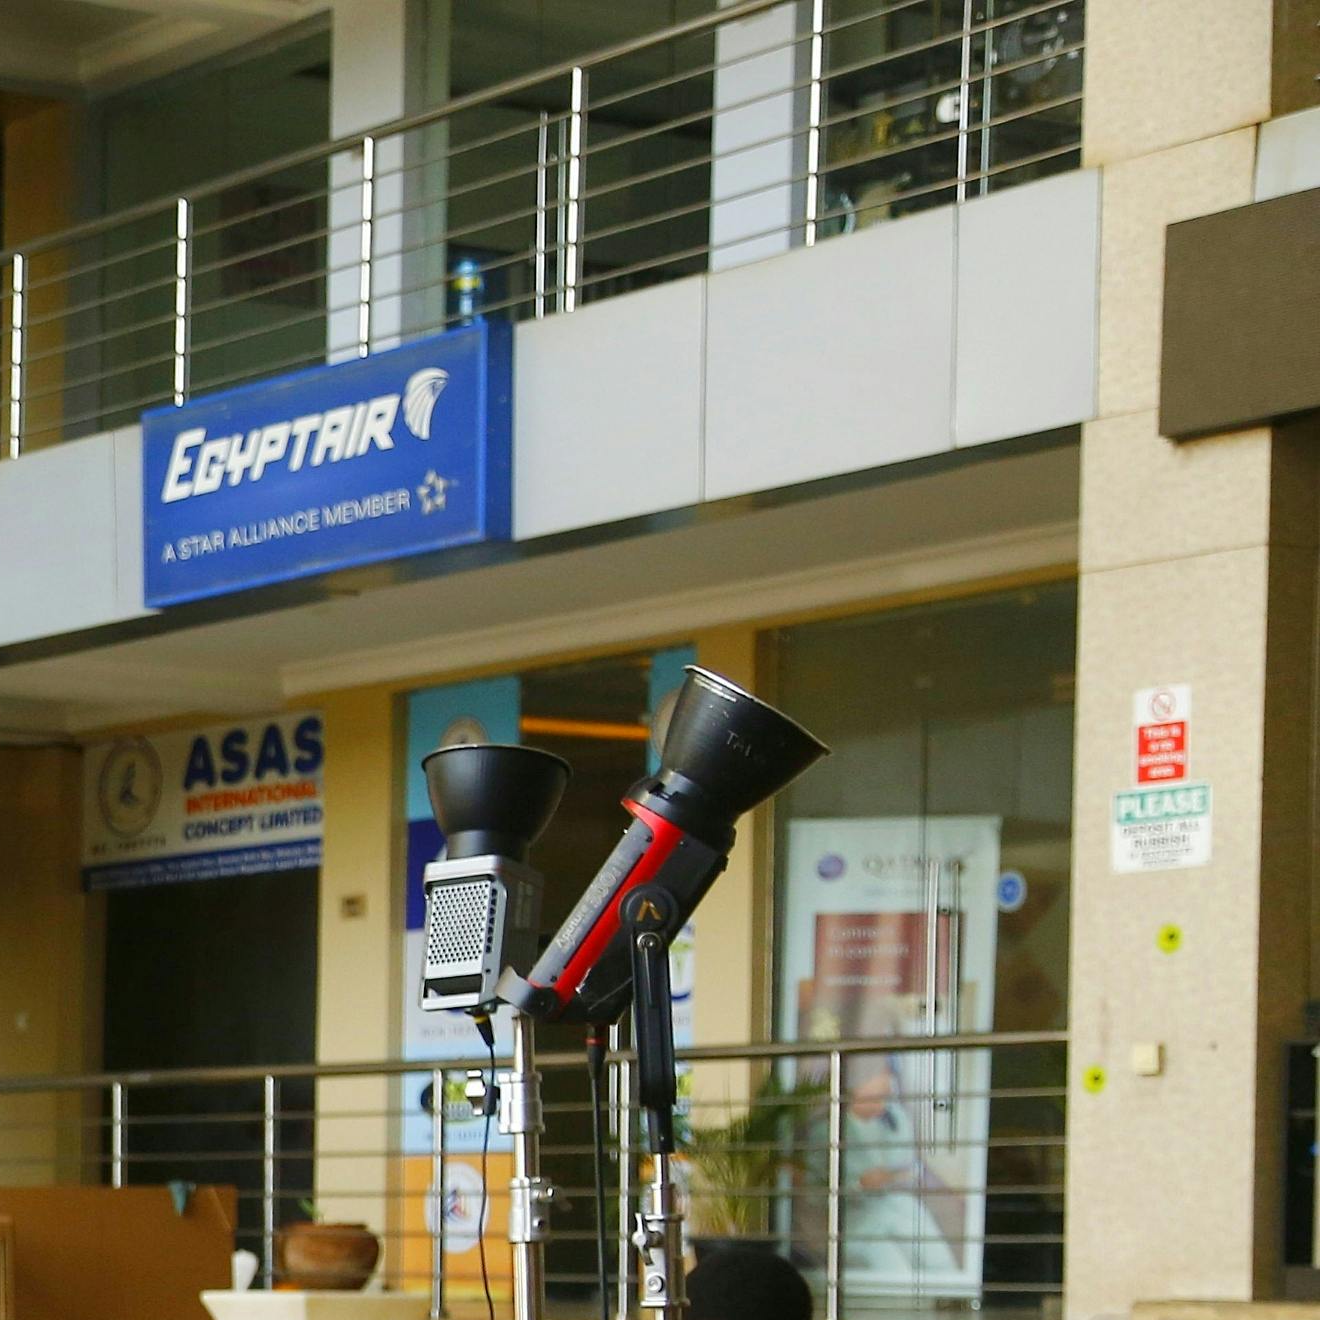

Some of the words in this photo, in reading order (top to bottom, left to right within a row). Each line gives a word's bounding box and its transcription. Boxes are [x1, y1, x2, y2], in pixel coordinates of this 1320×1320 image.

[162, 394, 401, 503] EGYPTAIR
[162, 543, 177, 564] A
[179, 530, 225, 560] STAR
[228, 508, 321, 548] ALLIANCE
[322, 489, 412, 528] MEMBER
[183, 715, 324, 791] ASAS
[185, 815, 255, 840] CONCEPT
[261, 806, 323, 830] LIMITED
[186, 780, 317, 816] INTERNATIONAL
[1118, 789, 1205, 819] PLEASE
